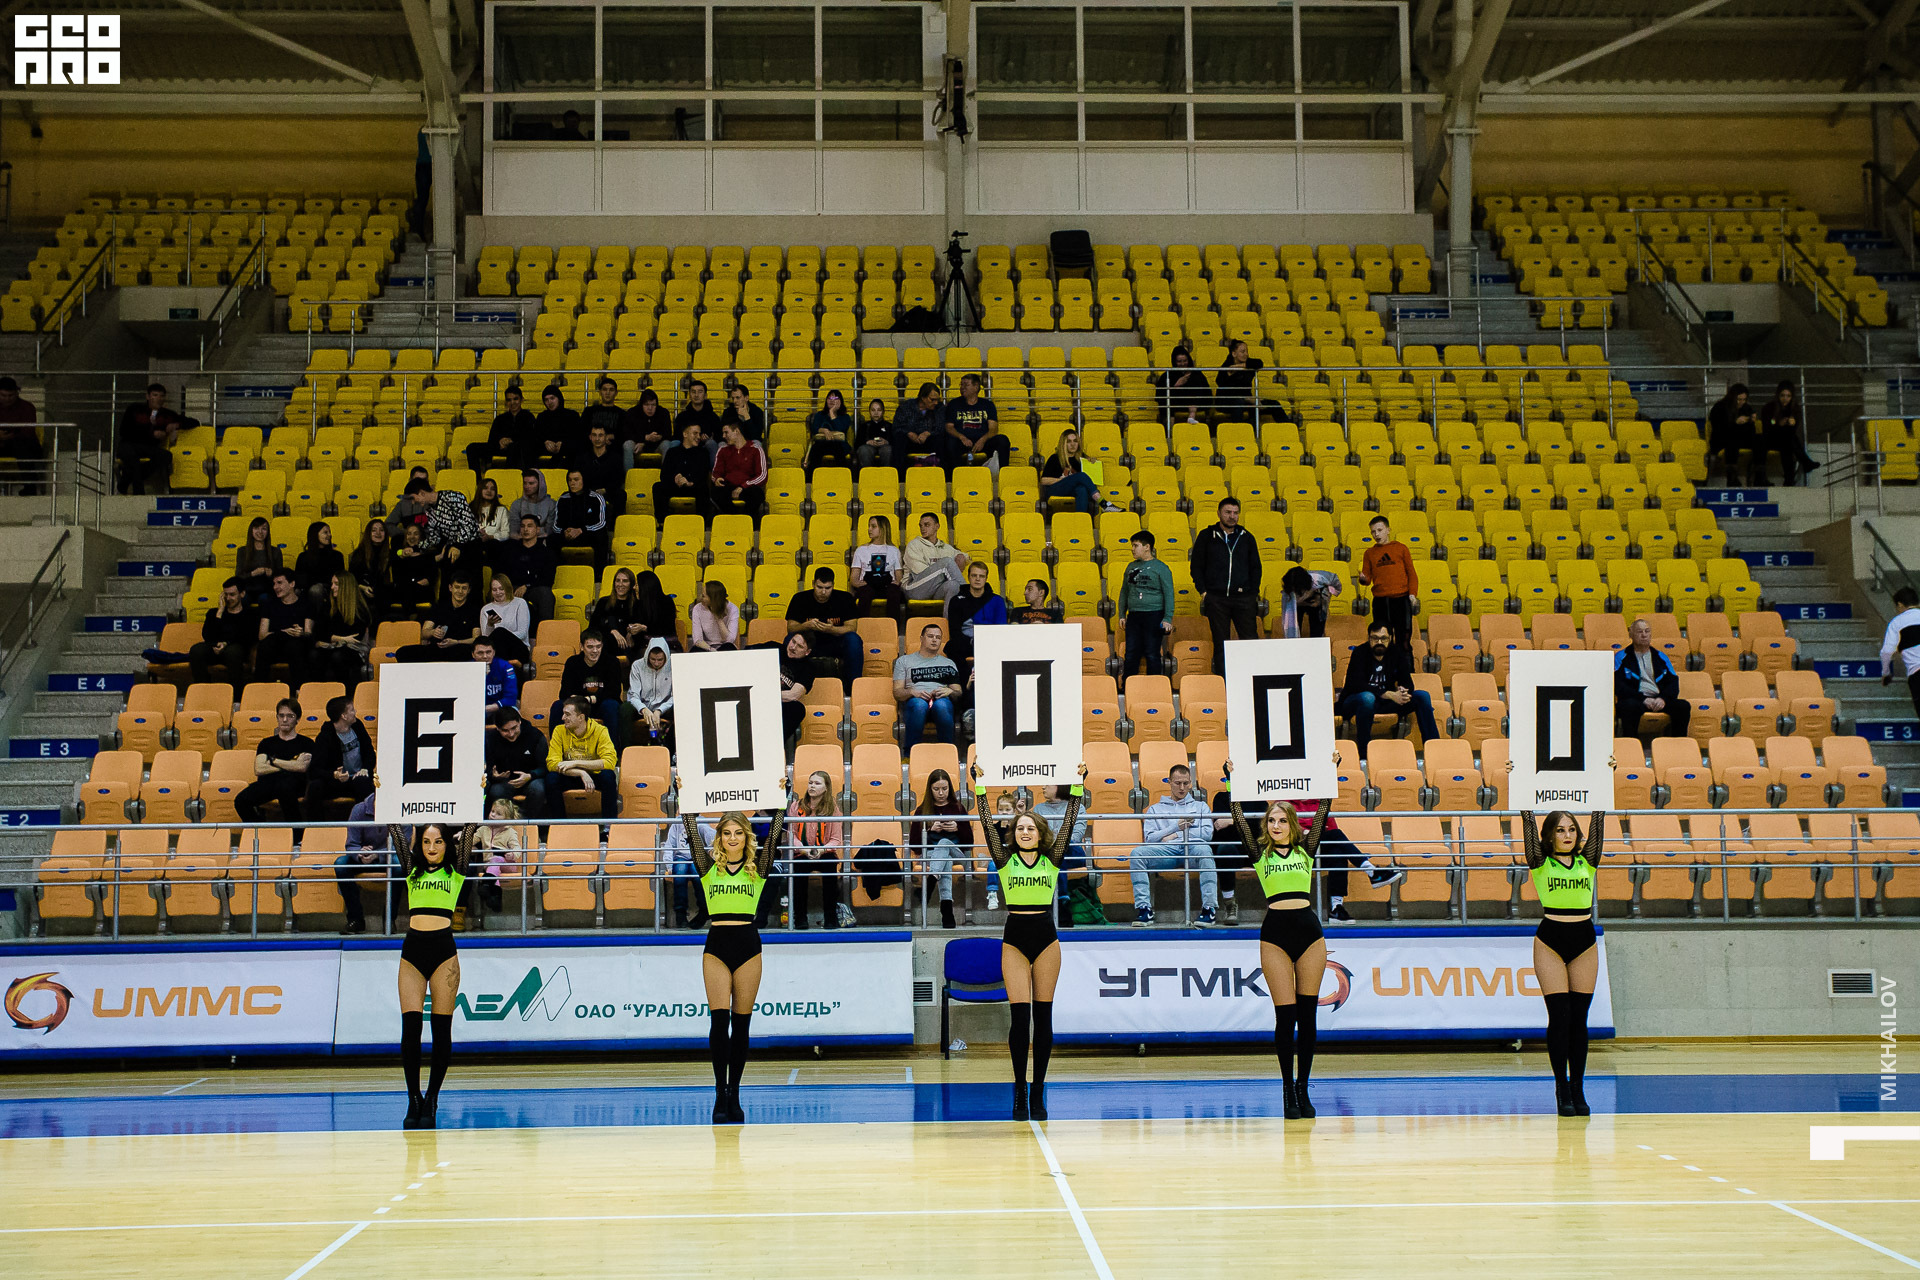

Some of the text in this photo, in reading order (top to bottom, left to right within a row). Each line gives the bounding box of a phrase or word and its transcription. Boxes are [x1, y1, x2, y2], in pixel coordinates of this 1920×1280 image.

[1720, 492, 1744, 502] E 8
[181, 500, 206, 511] E 8
[1730, 507, 1755, 518] E 7
[173, 515, 198, 526] E 7
[1764, 555, 1790, 566] E 6
[145, 565, 171, 577] E 6
[1800, 607, 1826, 619] E 5
[113, 619, 140, 631] E 5
[1840, 664, 1867, 676] E 4
[77, 677, 106, 690] E 4
[1001, 660, 1055, 750] 0
[1252, 674, 1306, 765] 0
[700, 686, 754, 776] 0
[1535, 686, 1588, 775] 0
[1884, 726, 1912, 739] E 3
[40, 742, 70, 756] E 3
[402, 697, 458, 787] 6
[1002, 764, 1057, 780] MADSHOT
[1257, 777, 1311, 795] MADSHOT
[705, 789, 760, 807] MADSHOT
[1535, 789, 1589, 805] MADSHOT
[401, 801, 457, 817] MADSHOT
[0, 814, 30, 826] E 2
[708, 884, 755, 900] УРАЛМАШ
[1547, 877, 1592, 893] УРАЛМА
[1098, 967, 1270, 998] УГМК
[92, 985, 283, 1018] UMMC
[574, 1001, 841, 1018] ОАО “УРАЛЭЛРОМЕДЬ”
